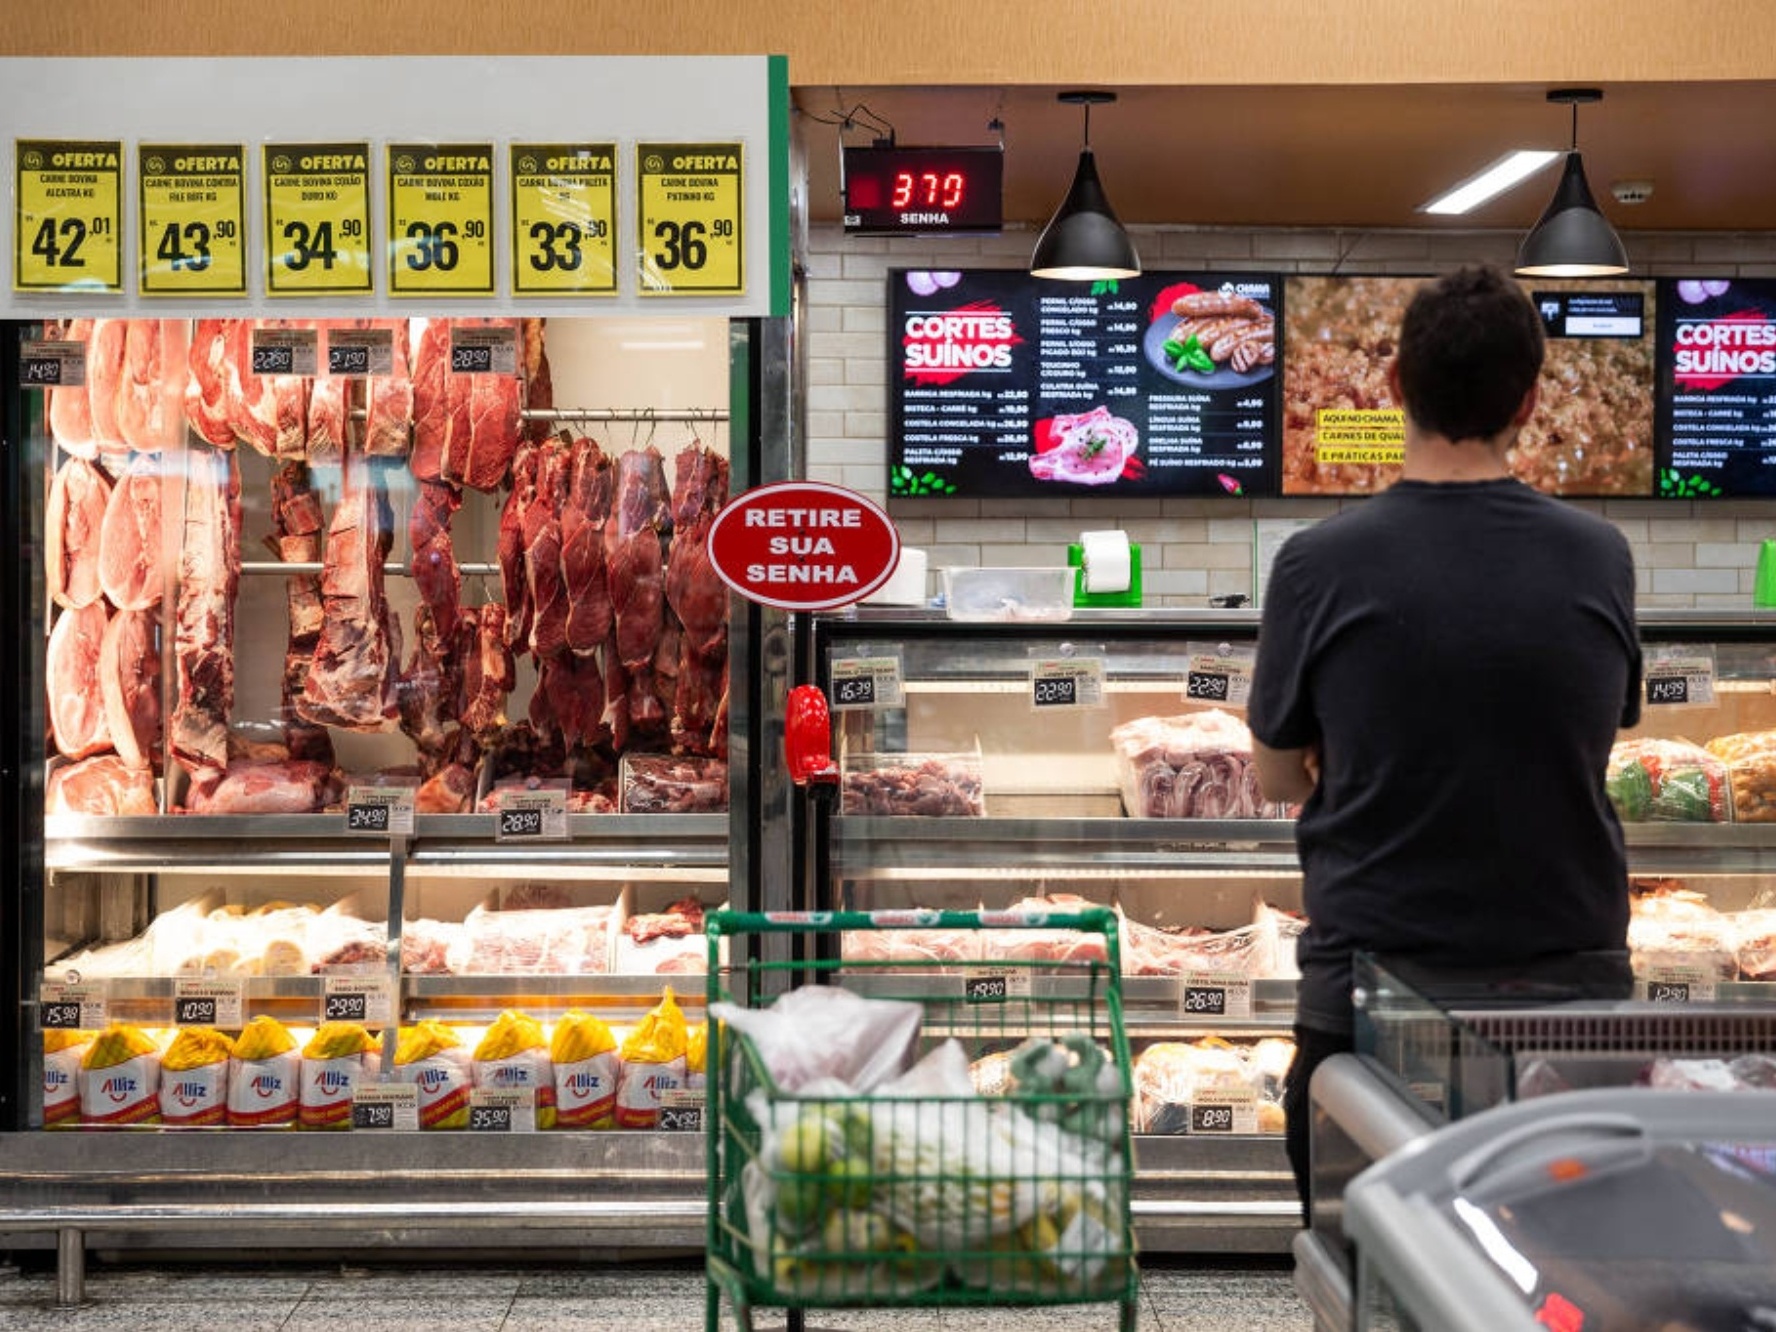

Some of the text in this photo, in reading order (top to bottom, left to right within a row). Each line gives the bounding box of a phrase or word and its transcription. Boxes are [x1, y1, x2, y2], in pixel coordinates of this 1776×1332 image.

[52, 152, 117, 167] OFERTA
[174, 157, 239, 171] OFERTA
[300, 156, 365, 170] OFERTA
[424, 157, 490, 171] OFERTA
[546, 156, 612, 170] OFERTA
[673, 156, 738, 170] OFERTA
[40, 174, 97, 183] CARNE BOVINA
[146, 178, 172, 188] CARNE
[175, 178, 203, 188] BOVINA
[274, 178, 299, 187] CARNE
[303, 177, 332, 187] BOVINA
[398, 178, 423, 187] CARNE
[427, 178, 455, 187] BOVINA
[661, 178, 718, 187] CARNE BOVINA
[46, 188, 81, 198] ALCATRA
[900, 213, 949, 224] SENHA
[32, 217, 110, 267] 42,01
[157, 220, 235, 271] 43,90
[283, 219, 361, 270] 34,90
[406, 219, 484, 271] 36,90
[654, 219, 732, 271] 36,90
[905, 317, 1013, 339] CORTES
[1676, 323, 1776, 346] CORTES
[905, 337, 1013, 367] SUÍNOS
[1676, 345, 1776, 373] SUÍNOS
[1323, 431, 1362, 441] CARNES
[1365, 432, 1377, 440] DE
[745, 509, 862, 527] RETIRE
[769, 536, 834, 555] SUA
[747, 565, 858, 583] SENHA
[44, 1070, 68, 1084] lliz
[101, 1076, 137, 1093] Alliz
[250, 1075, 282, 1089] Alliz
[315, 1071, 350, 1086] Alliz
[565, 1073, 600, 1088] Alliz
[643, 1075, 678, 1090] Alliz
[172, 1082, 207, 1098] Alliz
